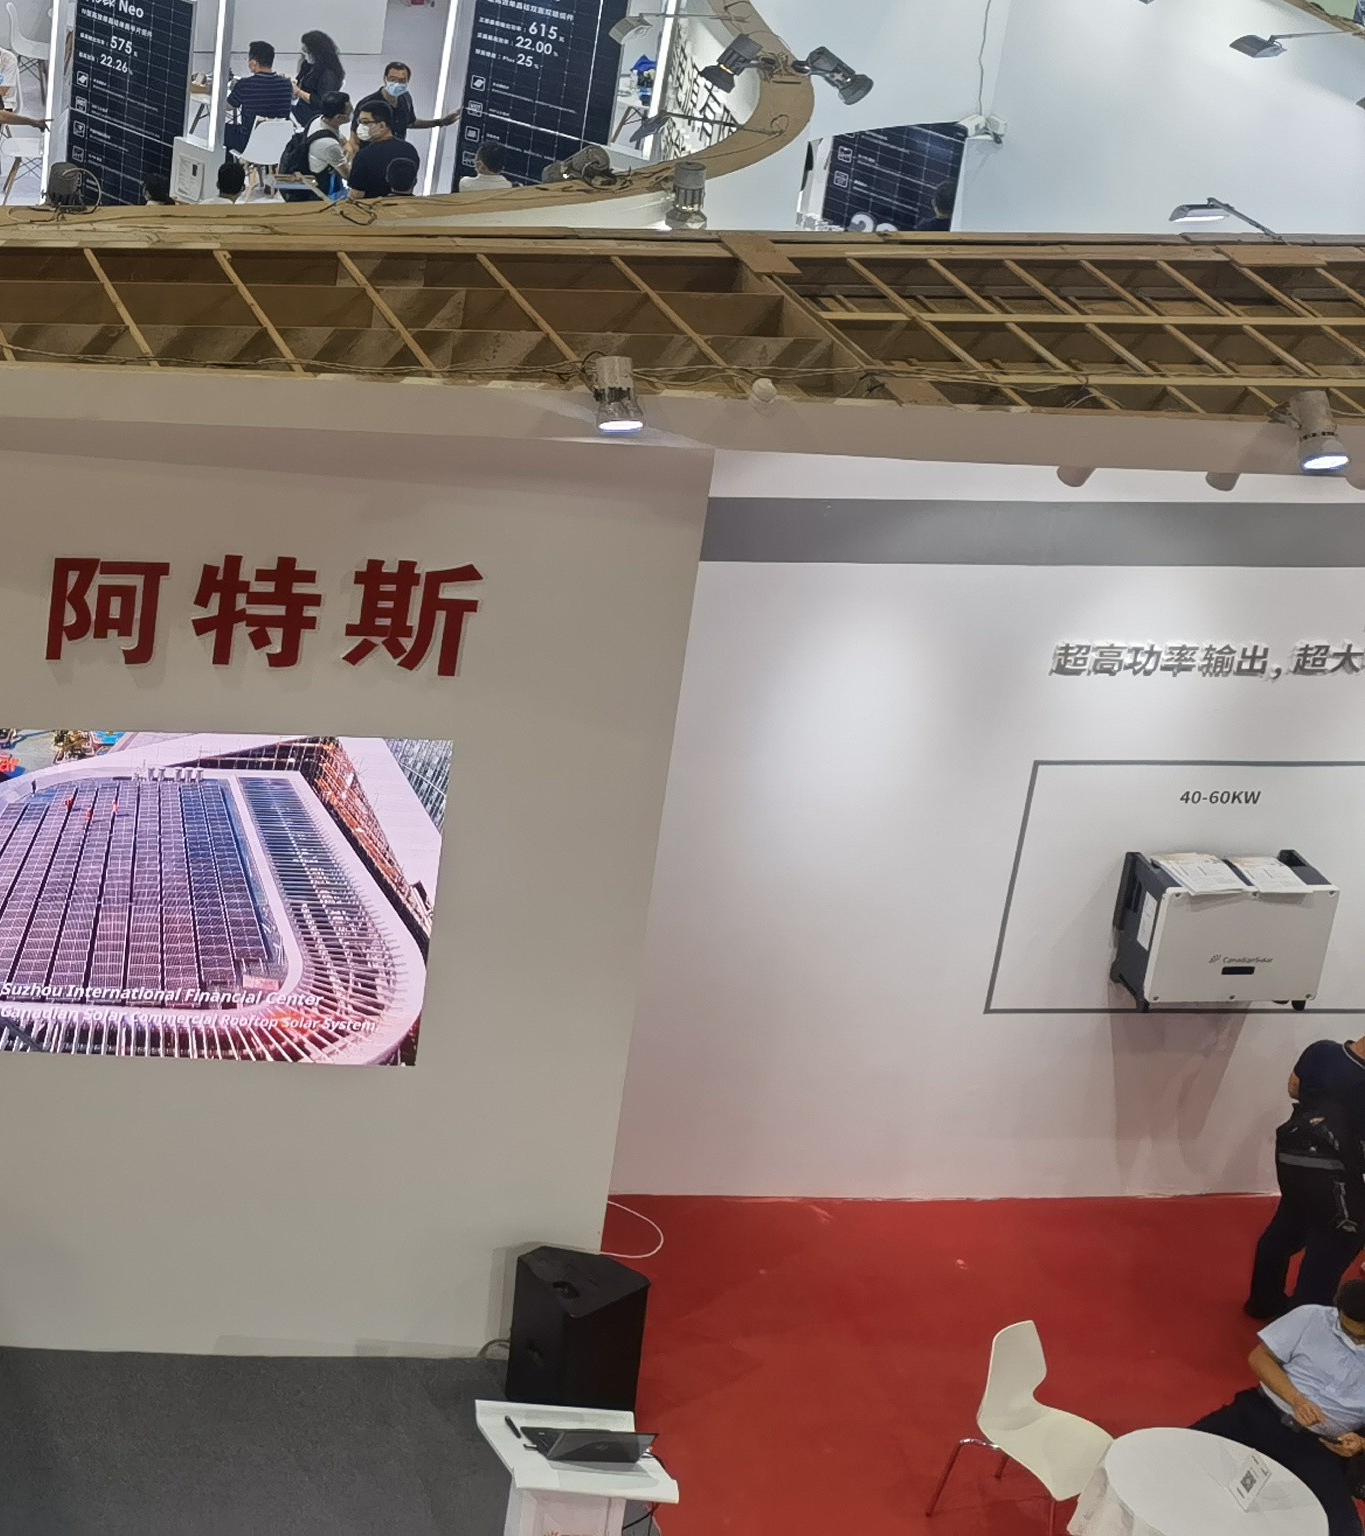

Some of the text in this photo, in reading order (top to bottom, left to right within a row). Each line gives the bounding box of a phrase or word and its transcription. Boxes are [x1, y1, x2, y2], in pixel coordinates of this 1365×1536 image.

[528, 21, 559, 41] 615
[110, 35, 134, 55] 575
[515, 35, 553, 56] 22.00
[99, 53, 128, 75] 22.26
[516, 52, 534, 69] 25
[45, 554, 485, 678] 阿特斯
[1179, 789, 1262, 806] 40-60KW
[0, 982, 325, 1008] Suzhou International Financial Center
[82, 1008, 127, 1023] Solar
[130, 1010, 218, 1027] Commercial
[221, 1012, 278, 1030] Rooftop
[280, 1017, 319, 1030] Solar
[322, 1018, 377, 1033] System
